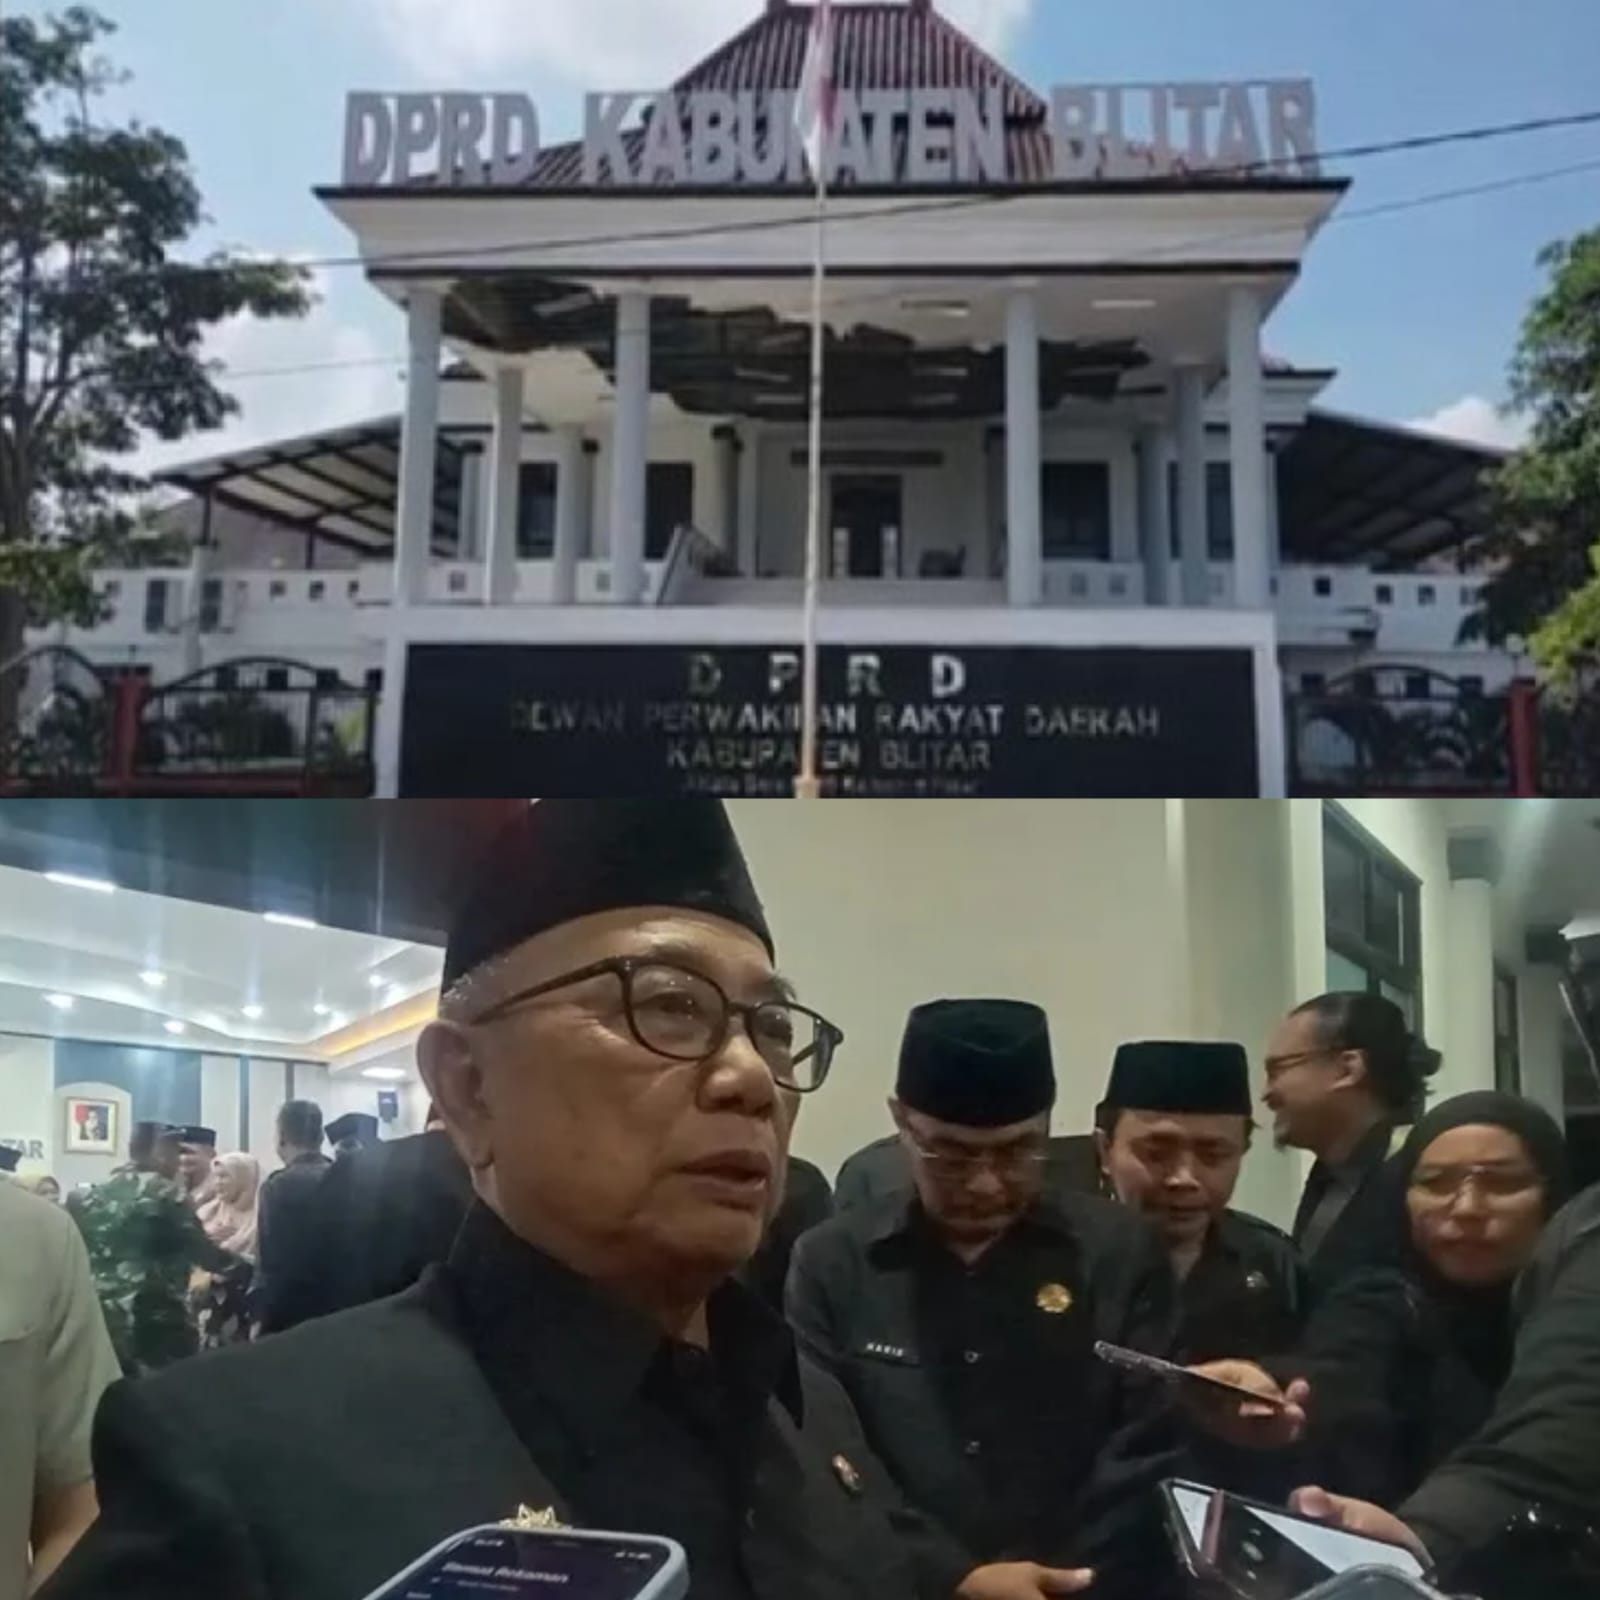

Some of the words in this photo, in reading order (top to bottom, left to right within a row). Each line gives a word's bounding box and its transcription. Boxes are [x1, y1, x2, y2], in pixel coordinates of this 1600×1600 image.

[341, 91, 540, 186] DPRD
[1049, 78, 1320, 181] BLITAR
[874, 702, 1004, 735] RAKYAT
[1024, 703, 1160, 737] DAERAH
[666, 738, 861, 770] KABUPAEN
[879, 739, 992, 771] BLITAR
